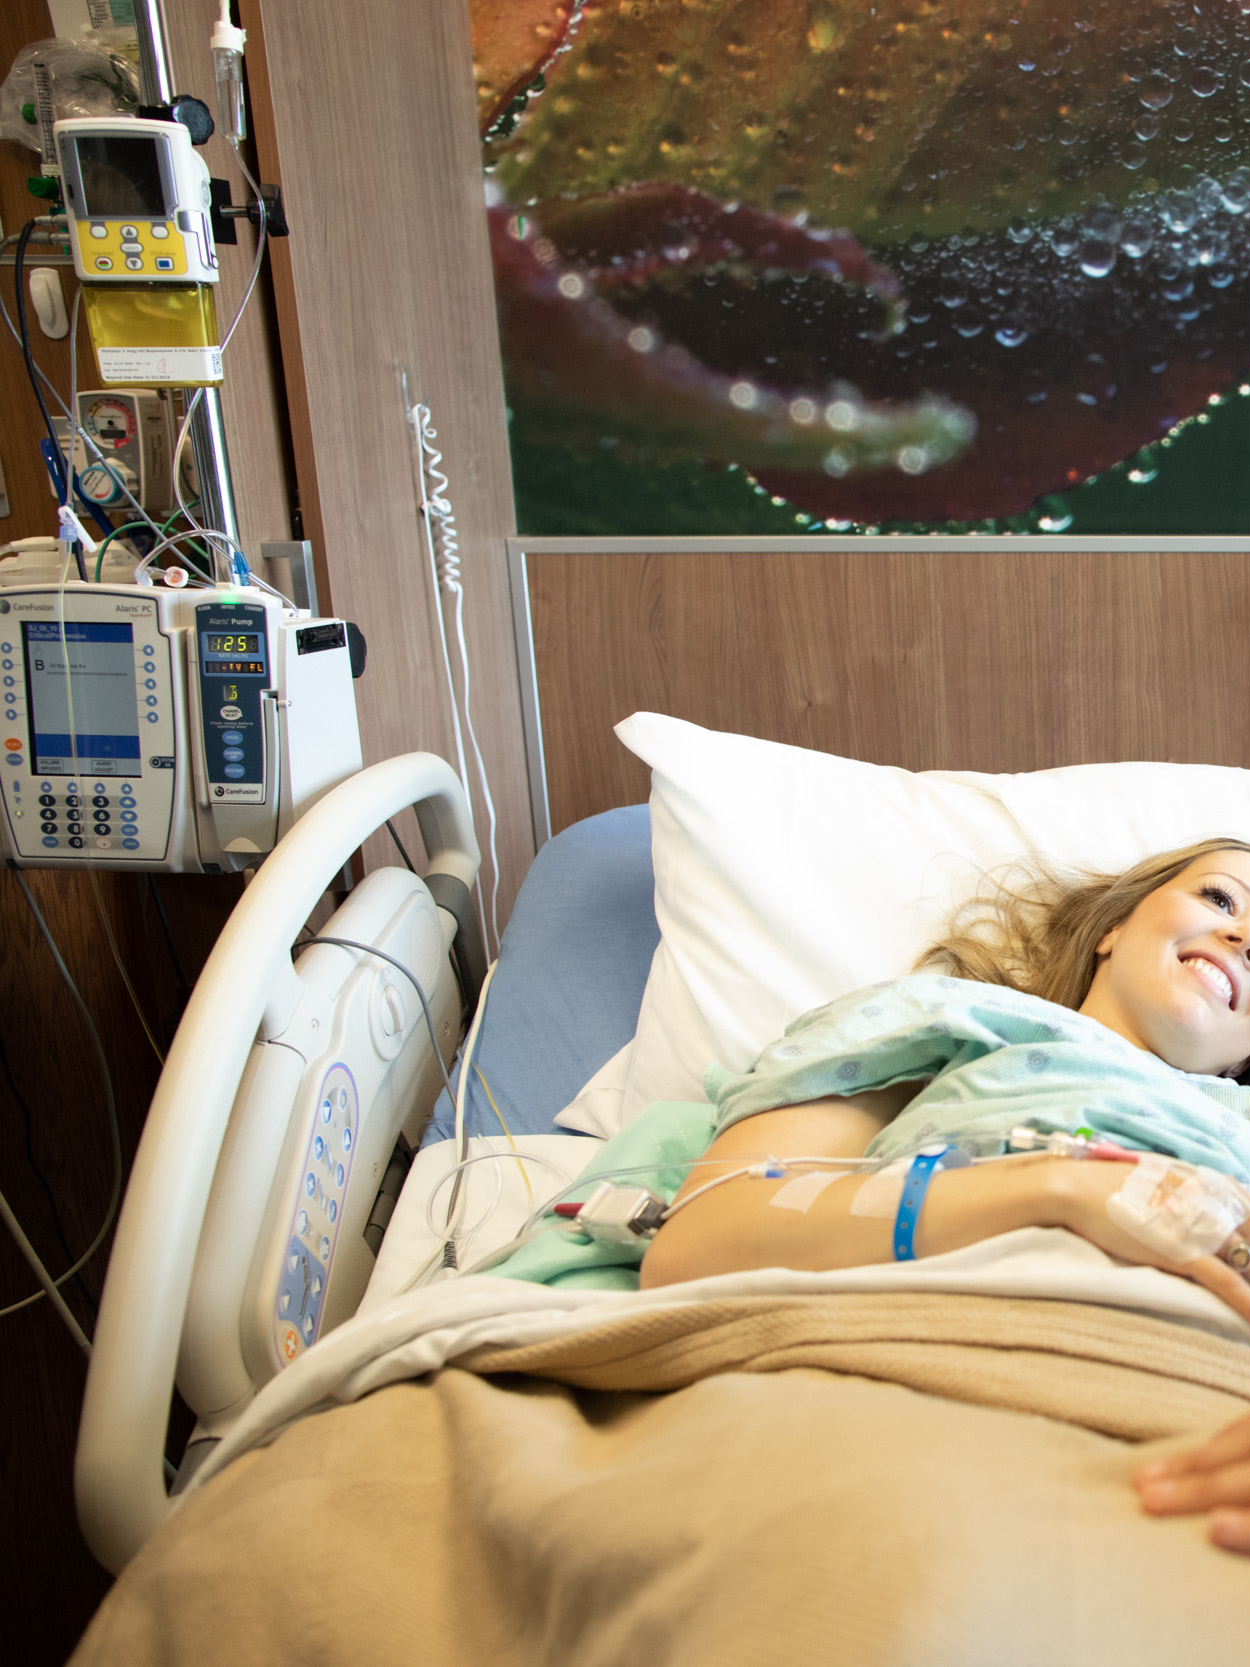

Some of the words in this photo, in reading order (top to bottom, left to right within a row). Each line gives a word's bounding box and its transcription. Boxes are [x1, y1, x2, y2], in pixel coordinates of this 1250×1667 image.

[13, 603, 55, 611] CareFusion
[231, 618, 253, 626] Pump
[216, 636, 247, 652] 125
[35, 659, 45, 670] B
[98, 798, 105, 806] 3
[45, 810, 52, 818] 4
[72, 811, 79, 819] 5
[98, 812, 106, 820] 6
[46, 824, 53, 832] 7
[72, 825, 79, 833] 8
[100, 825, 107, 833] 9
[74, 838, 81, 847] 0
